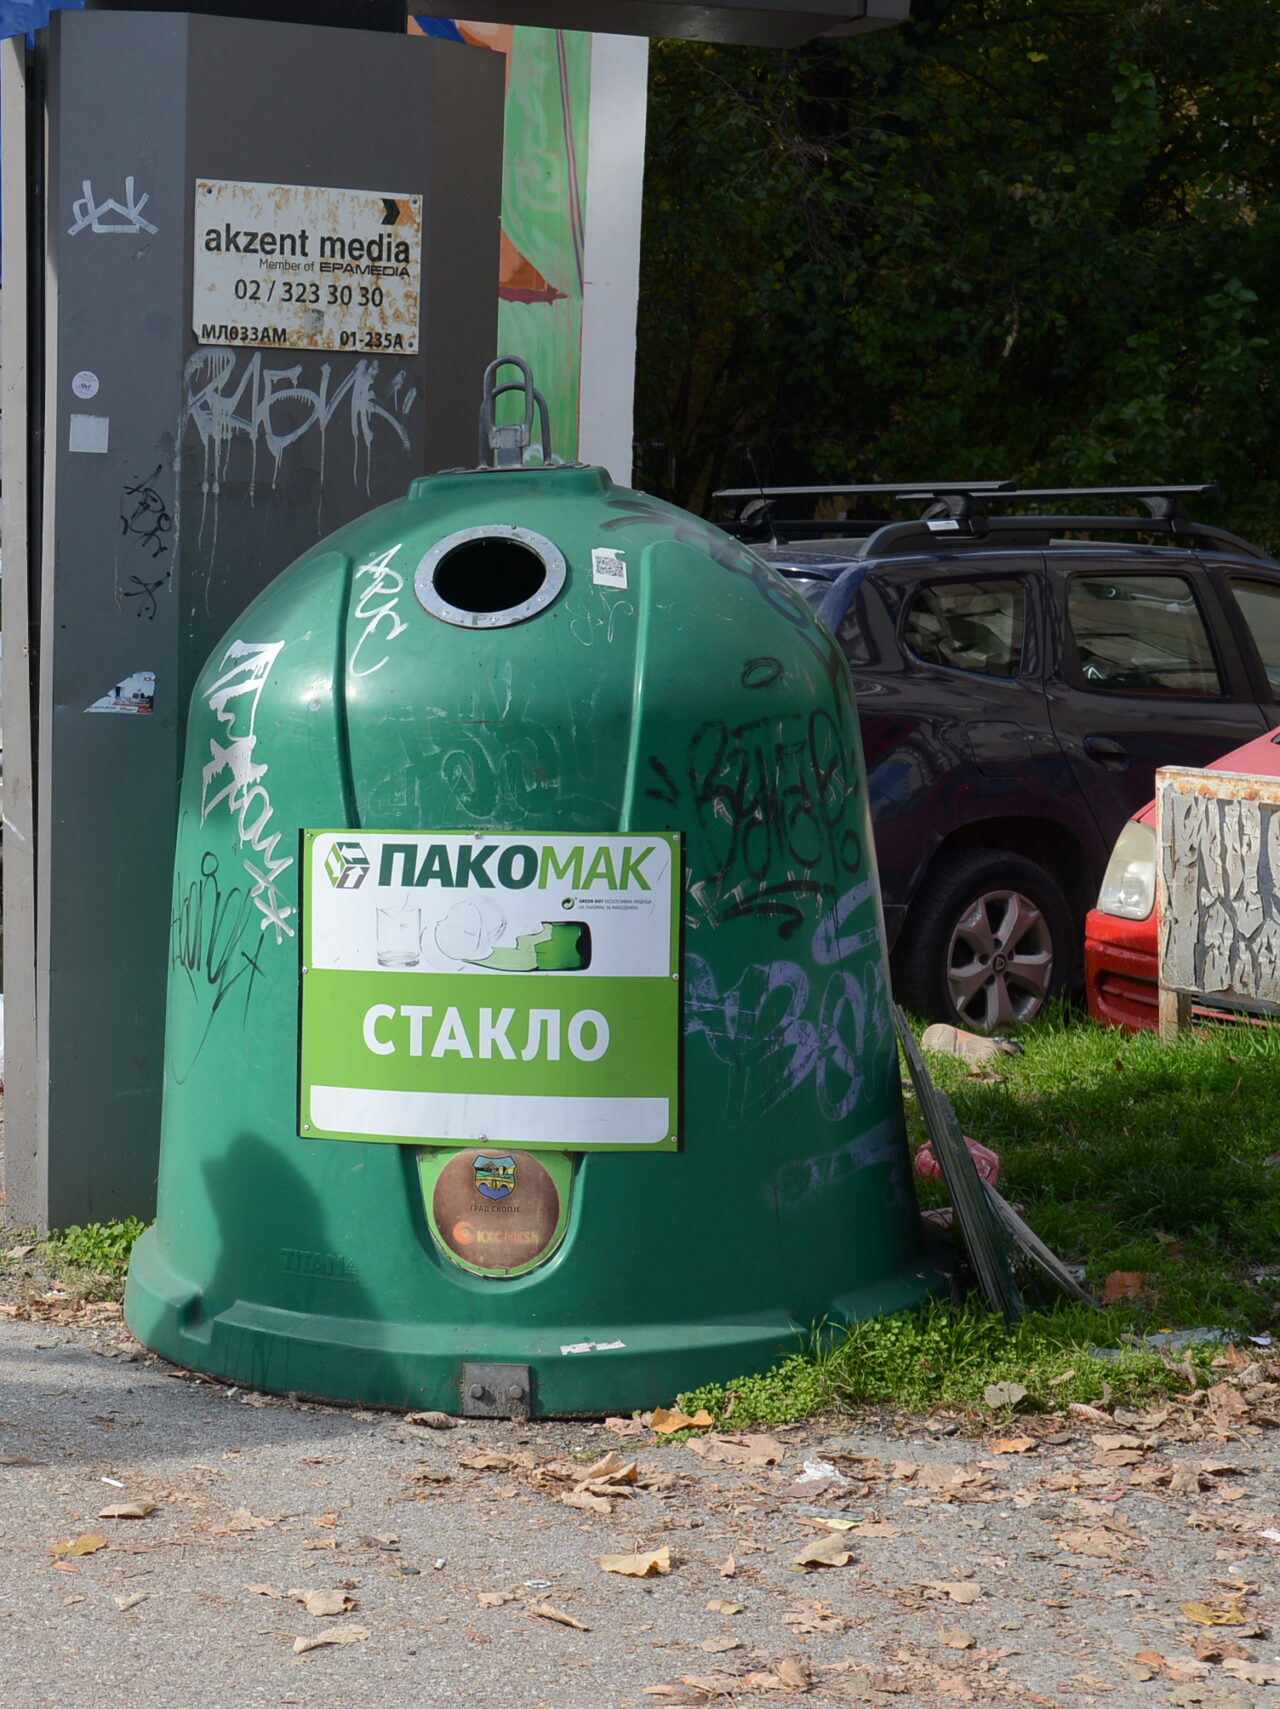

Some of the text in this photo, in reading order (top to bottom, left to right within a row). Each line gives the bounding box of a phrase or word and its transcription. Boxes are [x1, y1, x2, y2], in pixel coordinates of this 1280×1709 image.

[204, 222, 411, 264] akzent media
[259, 257, 411, 278] Member of EPAMEDIA
[234, 278, 384, 307] 02 / 323 30 30
[377, 842, 658, 892] ПАКОМАК
[362, 1003, 610, 1062] СТАКЛО
[470, 1204, 521, 1214] ГРАД СКОПЈЕ
